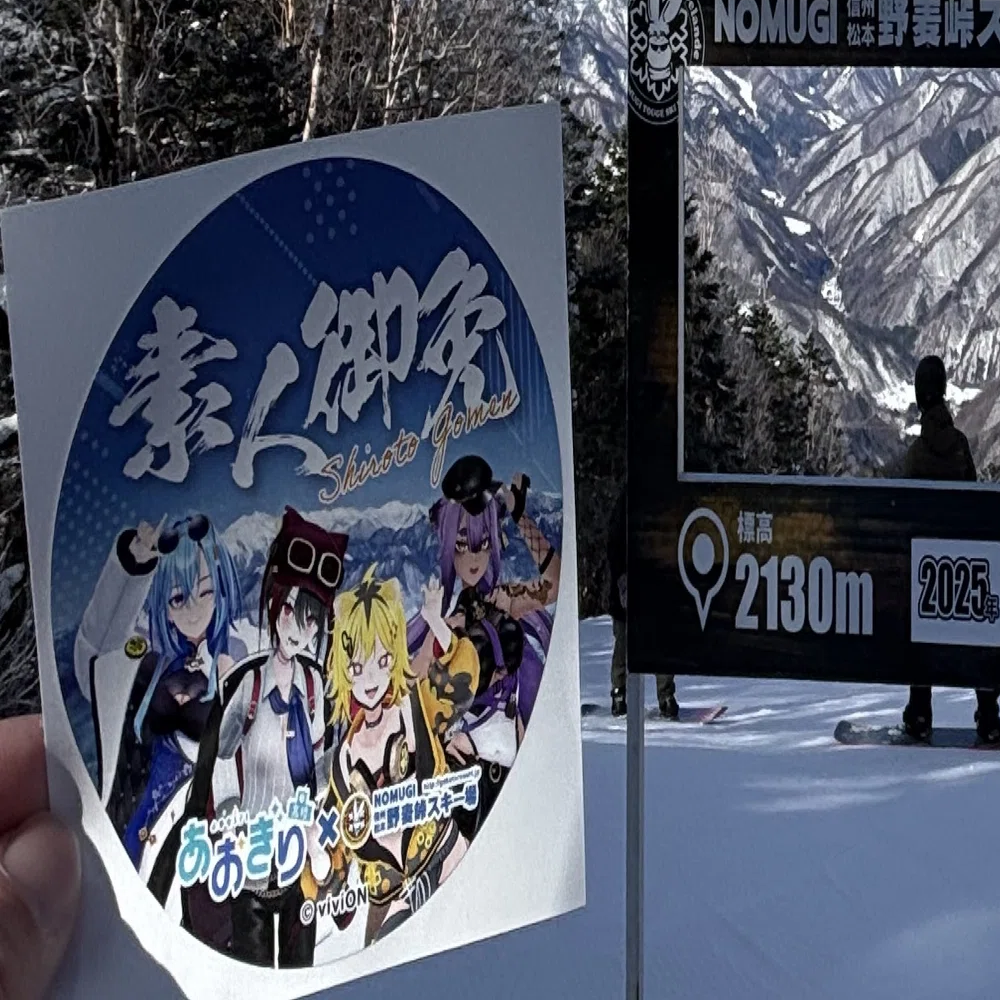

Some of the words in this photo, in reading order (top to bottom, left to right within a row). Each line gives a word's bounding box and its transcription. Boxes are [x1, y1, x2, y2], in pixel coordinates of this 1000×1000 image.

[847, 22, 875, 46] 松本
[319, 428, 420, 504] Shiroto
[737, 510, 774, 544] 標高
[735, 553, 874, 635] 2130m
[918, 555, 1000, 624] 2025年
[373, 783, 416, 808] NOMUGI
[177, 816, 306, 898] あおぎり
